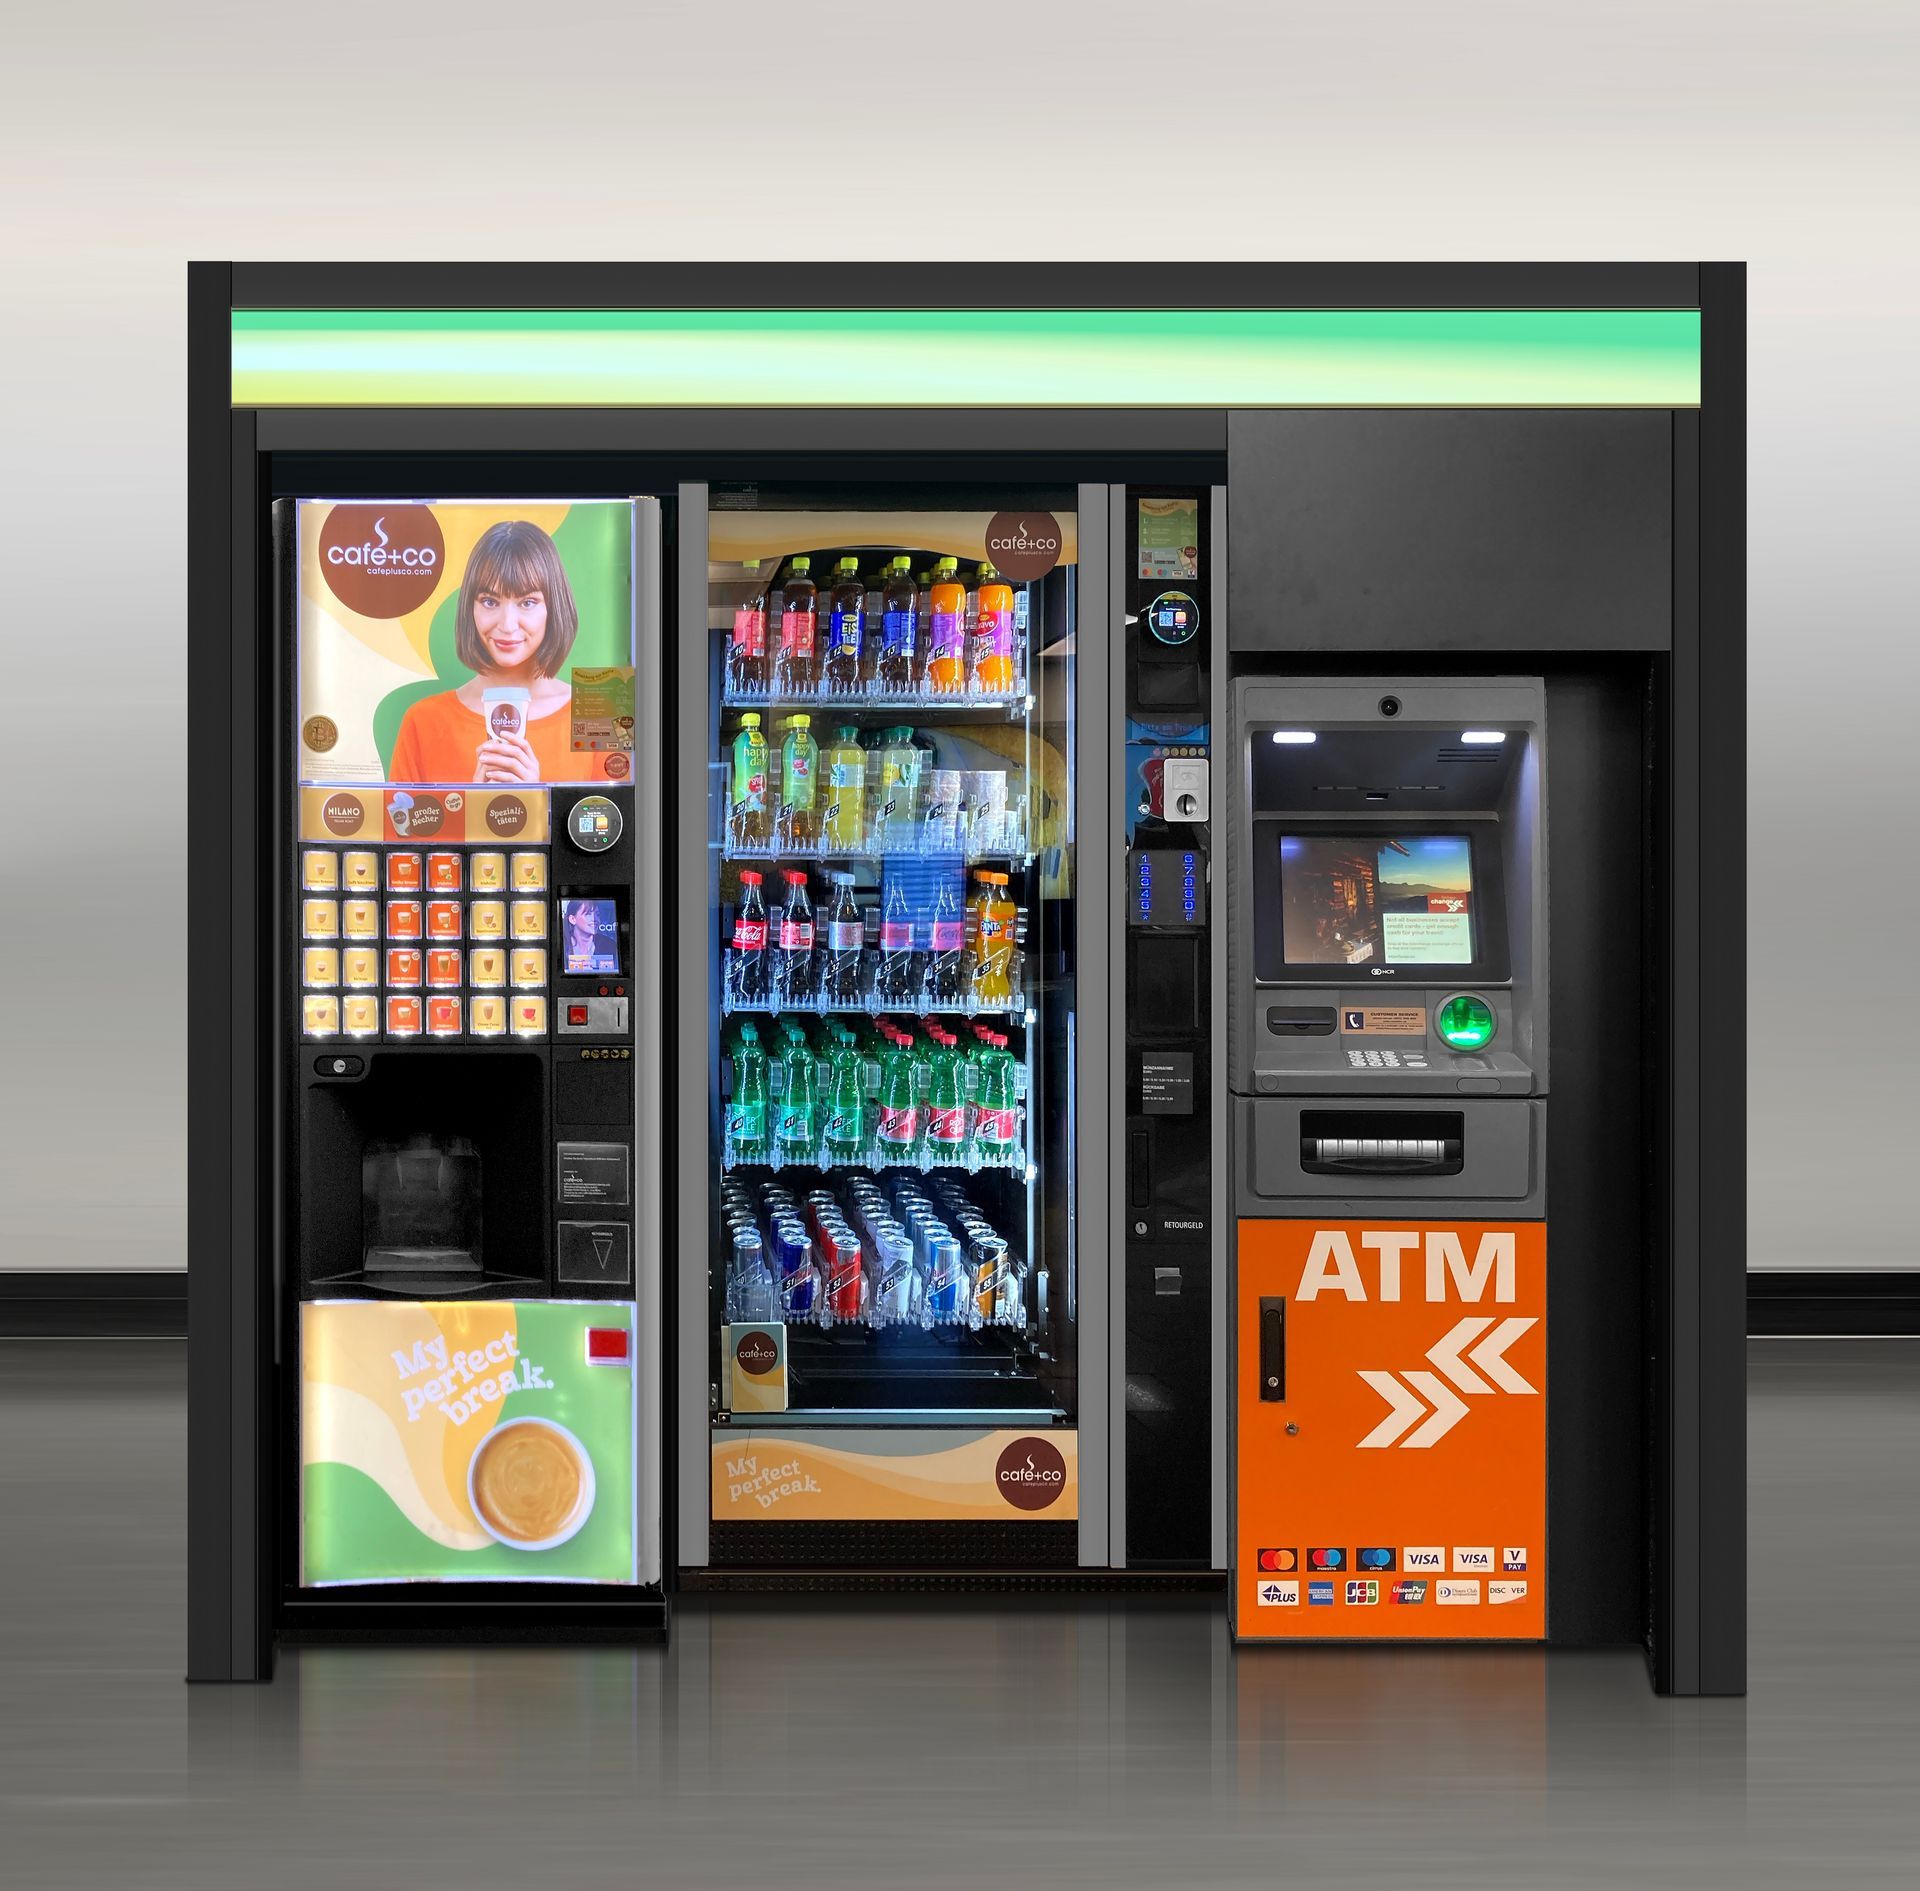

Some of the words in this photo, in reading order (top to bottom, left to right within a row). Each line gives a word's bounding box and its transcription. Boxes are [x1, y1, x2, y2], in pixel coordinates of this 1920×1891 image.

[367, 567, 432, 576] cafeplusco.com
[734, 645, 743, 655] 10
[782, 647, 791, 657] 11
[833, 647, 842, 657] 12
[887, 646, 895, 656] 13
[935, 646, 945, 656] 14
[981, 648, 989, 659] 15
[328, 807, 360, 816] MILANO
[736, 801, 745, 812] 20
[783, 806, 792, 815] 21
[829, 806, 839, 816] 22
[887, 803, 895, 813] 23
[934, 806, 943, 817] 24
[981, 805, 989, 815] 25
[414, 806, 440, 818] großer
[490, 807, 524, 819] Speziali-
[412, 815, 439, 826] Becher
[497, 816, 518, 825] täten
[1141, 854, 1149, 863] 1
[1184, 854, 1193, 863] 6
[1141, 866, 1149, 875] 2
[1184, 866, 1193, 875] 7
[1141, 878, 1149, 887] 3
[1184, 878, 1193, 887] 8
[1141, 889, 1149, 898] 4
[1184, 889, 1193, 898] 9
[1141, 901, 1149, 910] 5
[1184, 901, 1193, 910] 0
[734, 960, 743, 971] 30
[786, 960, 793, 970] 31
[883, 963, 892, 973] 33
[982, 963, 990, 973] 35
[786, 1116, 794, 1127] 41
[887, 1119, 896, 1129] 43
[934, 1120, 942, 1131] 44
[985, 1121, 993, 1131] 45
[1164, 1221, 1204, 1229] RETOURGELD
[1295, 1230, 1516, 1303] ATM
[786, 1278, 794, 1288] 51
[833, 1278, 841, 1289] 52
[885, 1279, 894, 1290] 53
[391, 1334, 449, 1380] My
[401, 1330, 521, 1422] perfect
[438, 1358, 555, 1427] break.
[725, 1456, 757, 1478] My
[729, 1460, 801, 1502] perfect
[755, 1473, 821, 1509] break.
[1408, 1554, 1439, 1564] VISA
[1459, 1554, 1488, 1563] VISA
[1508, 1550, 1520, 1560] V
[1347, 1588, 1376, 1597] JCB
[1392, 1586, 1426, 1595] UnionPay
[1271, 1593, 1297, 1602] PLUS
